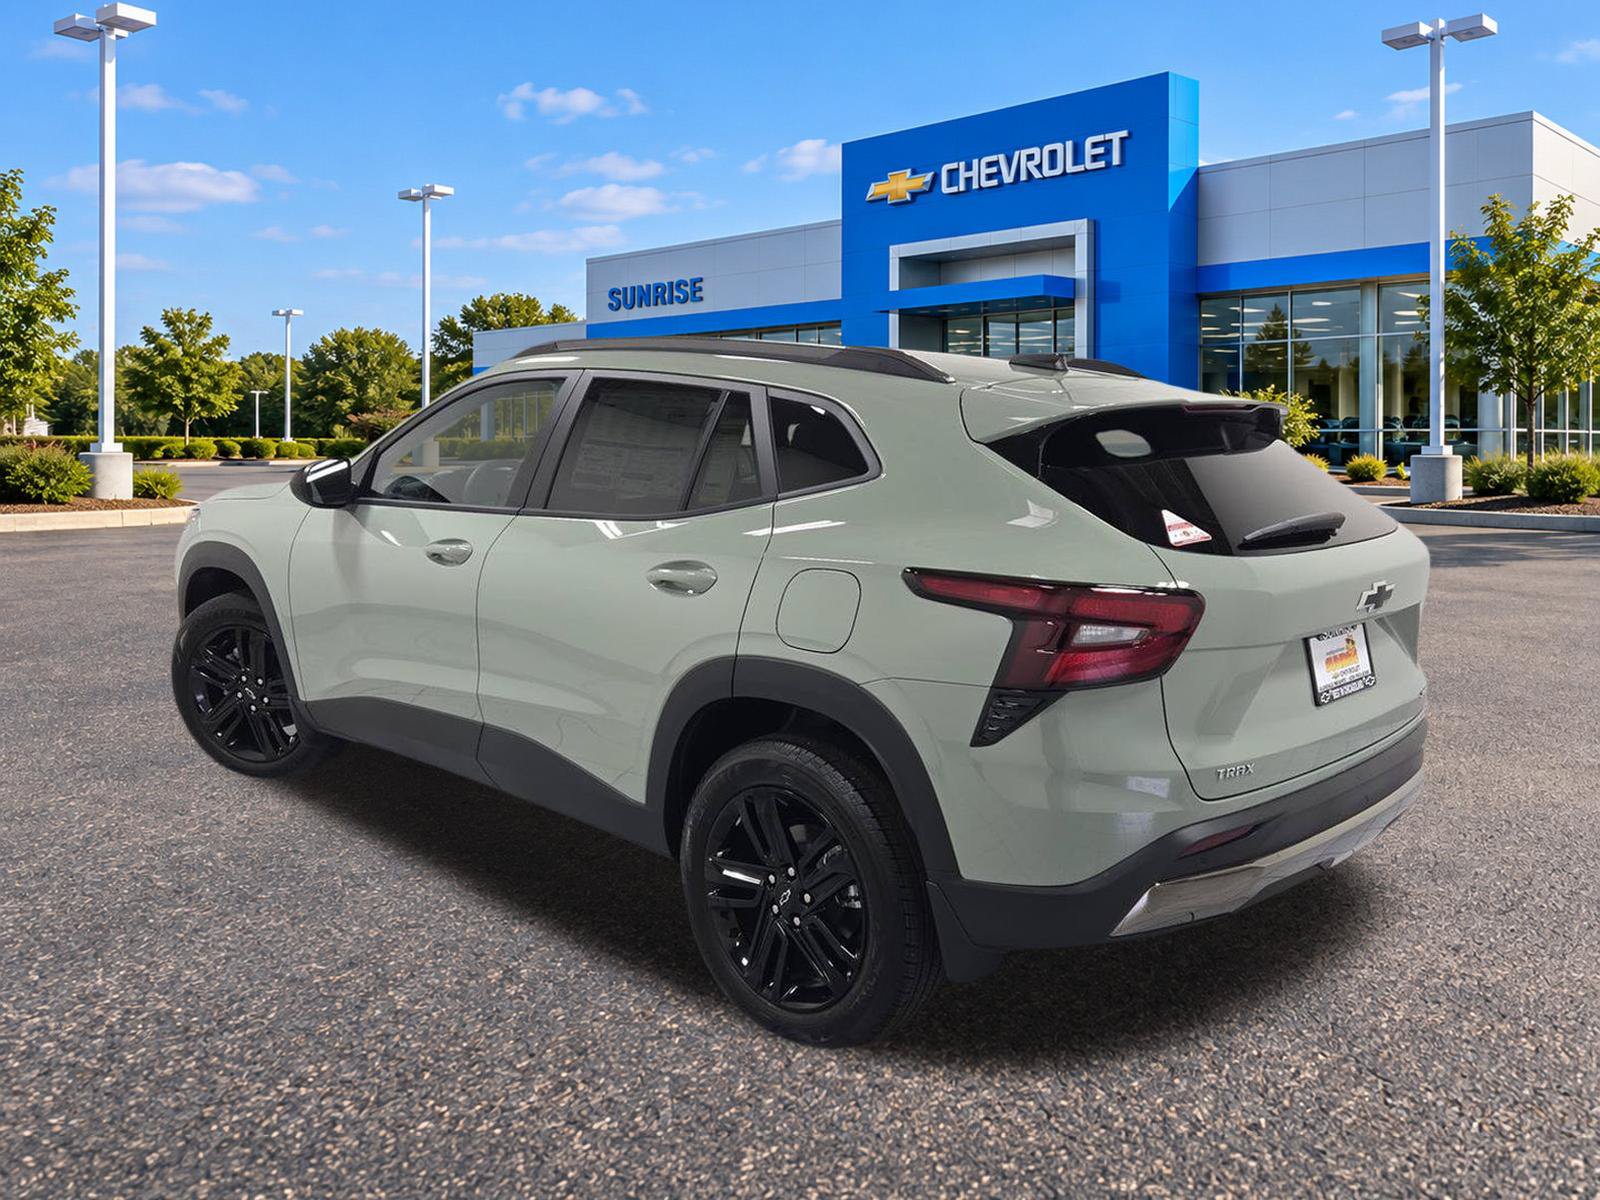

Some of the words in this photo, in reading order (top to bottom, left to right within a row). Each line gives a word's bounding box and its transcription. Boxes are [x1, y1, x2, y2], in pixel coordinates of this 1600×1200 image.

[941, 130, 1129, 194] CHEVROLET
[608, 277, 704, 312] SUNRISE
[1217, 763, 1255, 779] TRAX
